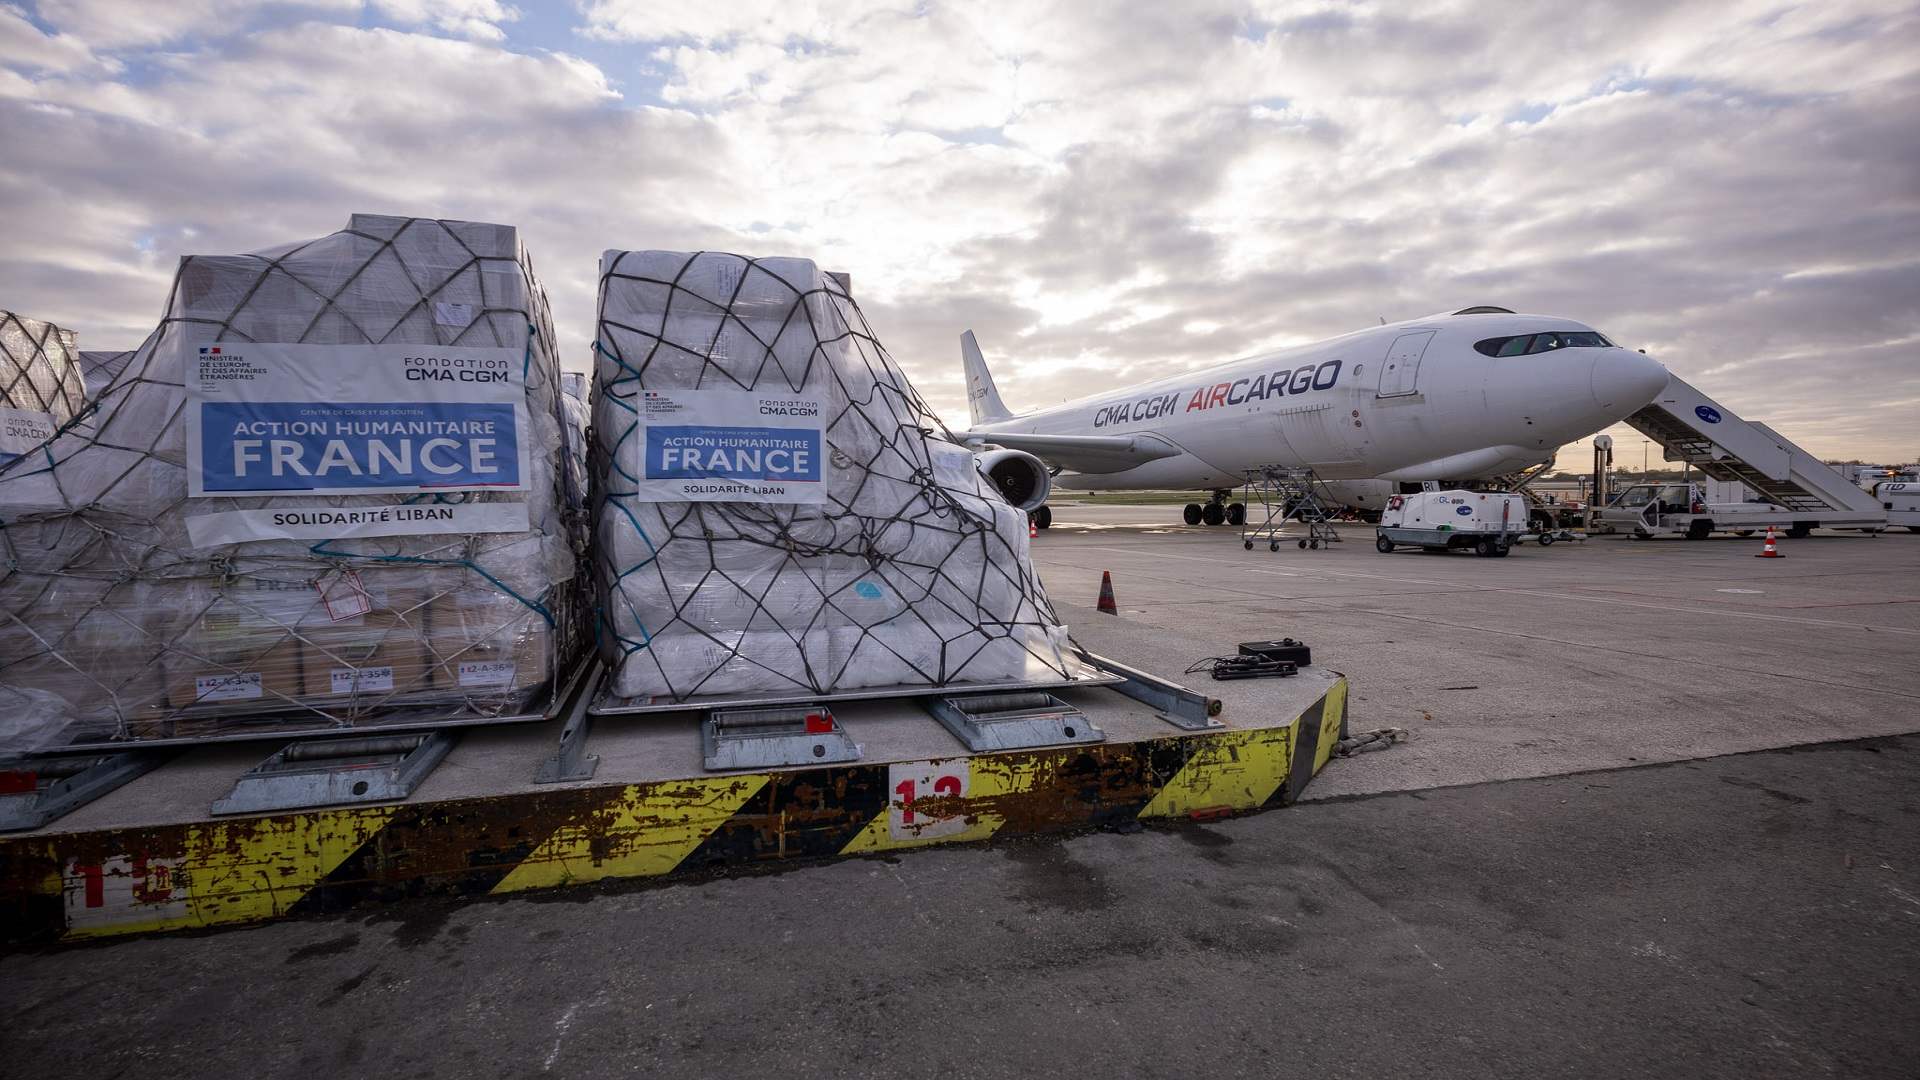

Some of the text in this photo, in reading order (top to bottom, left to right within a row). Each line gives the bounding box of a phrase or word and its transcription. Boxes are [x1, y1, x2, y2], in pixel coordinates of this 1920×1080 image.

[406, 368, 509, 383] CMA CGM
[1094, 359, 1342, 428] CMA CGM AIRCARGO
[759, 407, 818, 417] CMA CGM
[7, 426, 30, 438] CMA
[233, 420, 496, 436] ACTION HUMANITAIRE
[663, 437, 809, 449] ACTION HUMANITAIRE
[233, 437, 498, 477] FRANCE
[661, 448, 809, 474] FRANCE
[683, 484, 785, 495] SOLIDARITÉ LIBAN
[273, 508, 454, 526] SOLIDARITÉ LIBAN
